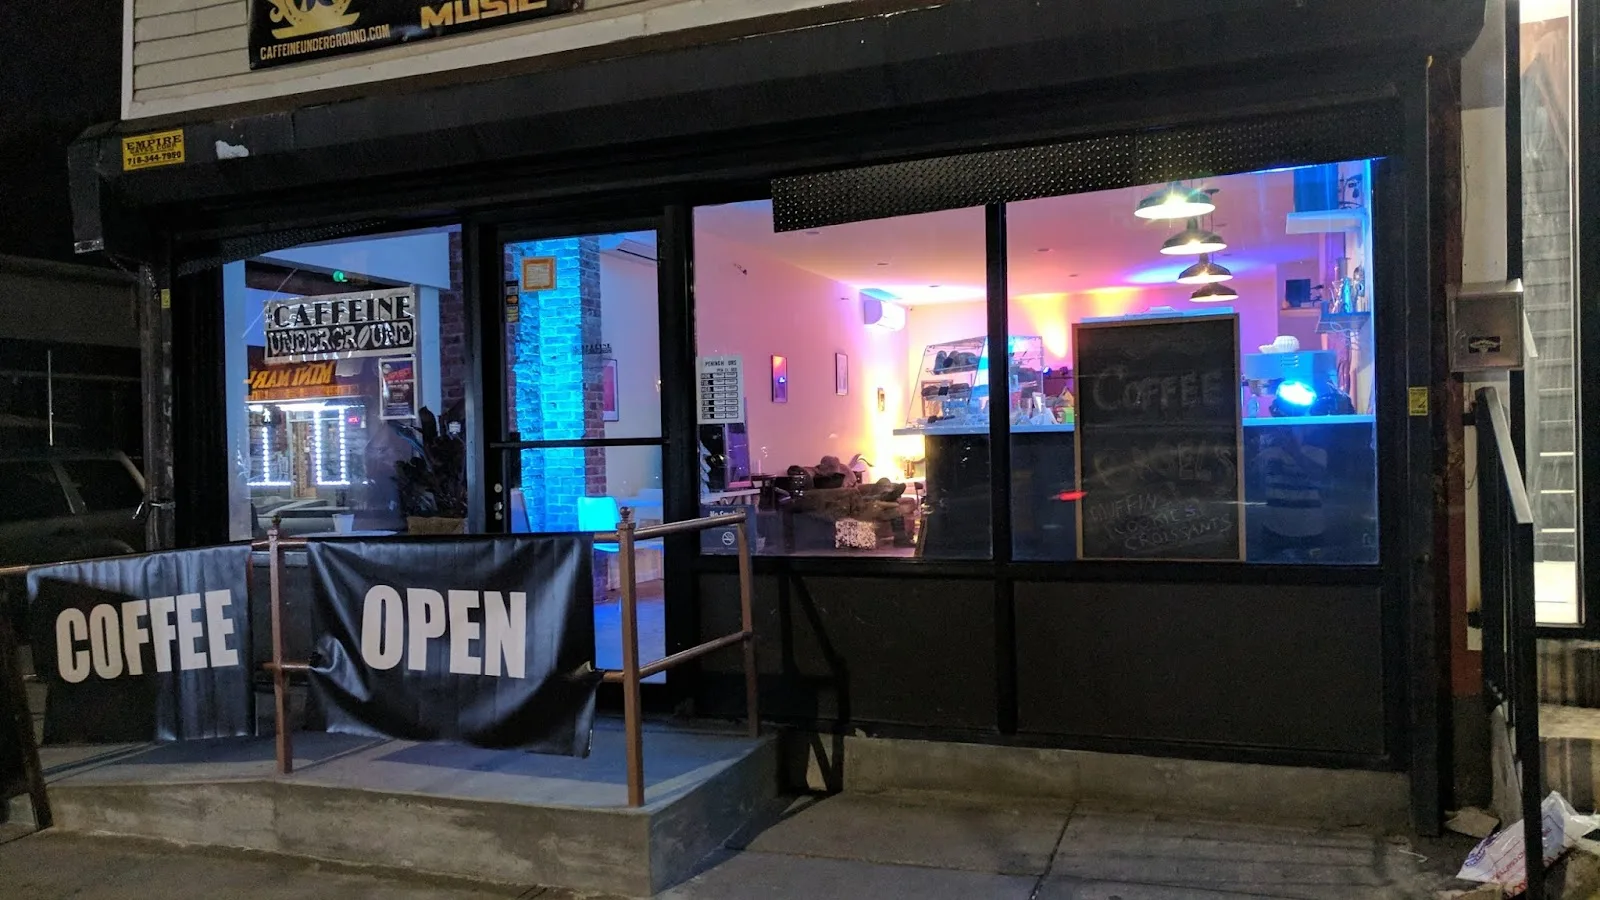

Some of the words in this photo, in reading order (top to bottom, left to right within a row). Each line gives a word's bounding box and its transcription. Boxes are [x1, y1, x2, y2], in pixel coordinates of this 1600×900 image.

[259, 24, 391, 61] CAFFEINEUNDERGROUND.COM
[126, 134, 182, 150] EMPIRE
[273, 295, 411, 328] CAFFEINE
[1093, 366, 1223, 410] COFFEE
[56, 589, 239, 683] COFFEE
[361, 584, 527, 679] OPEN
